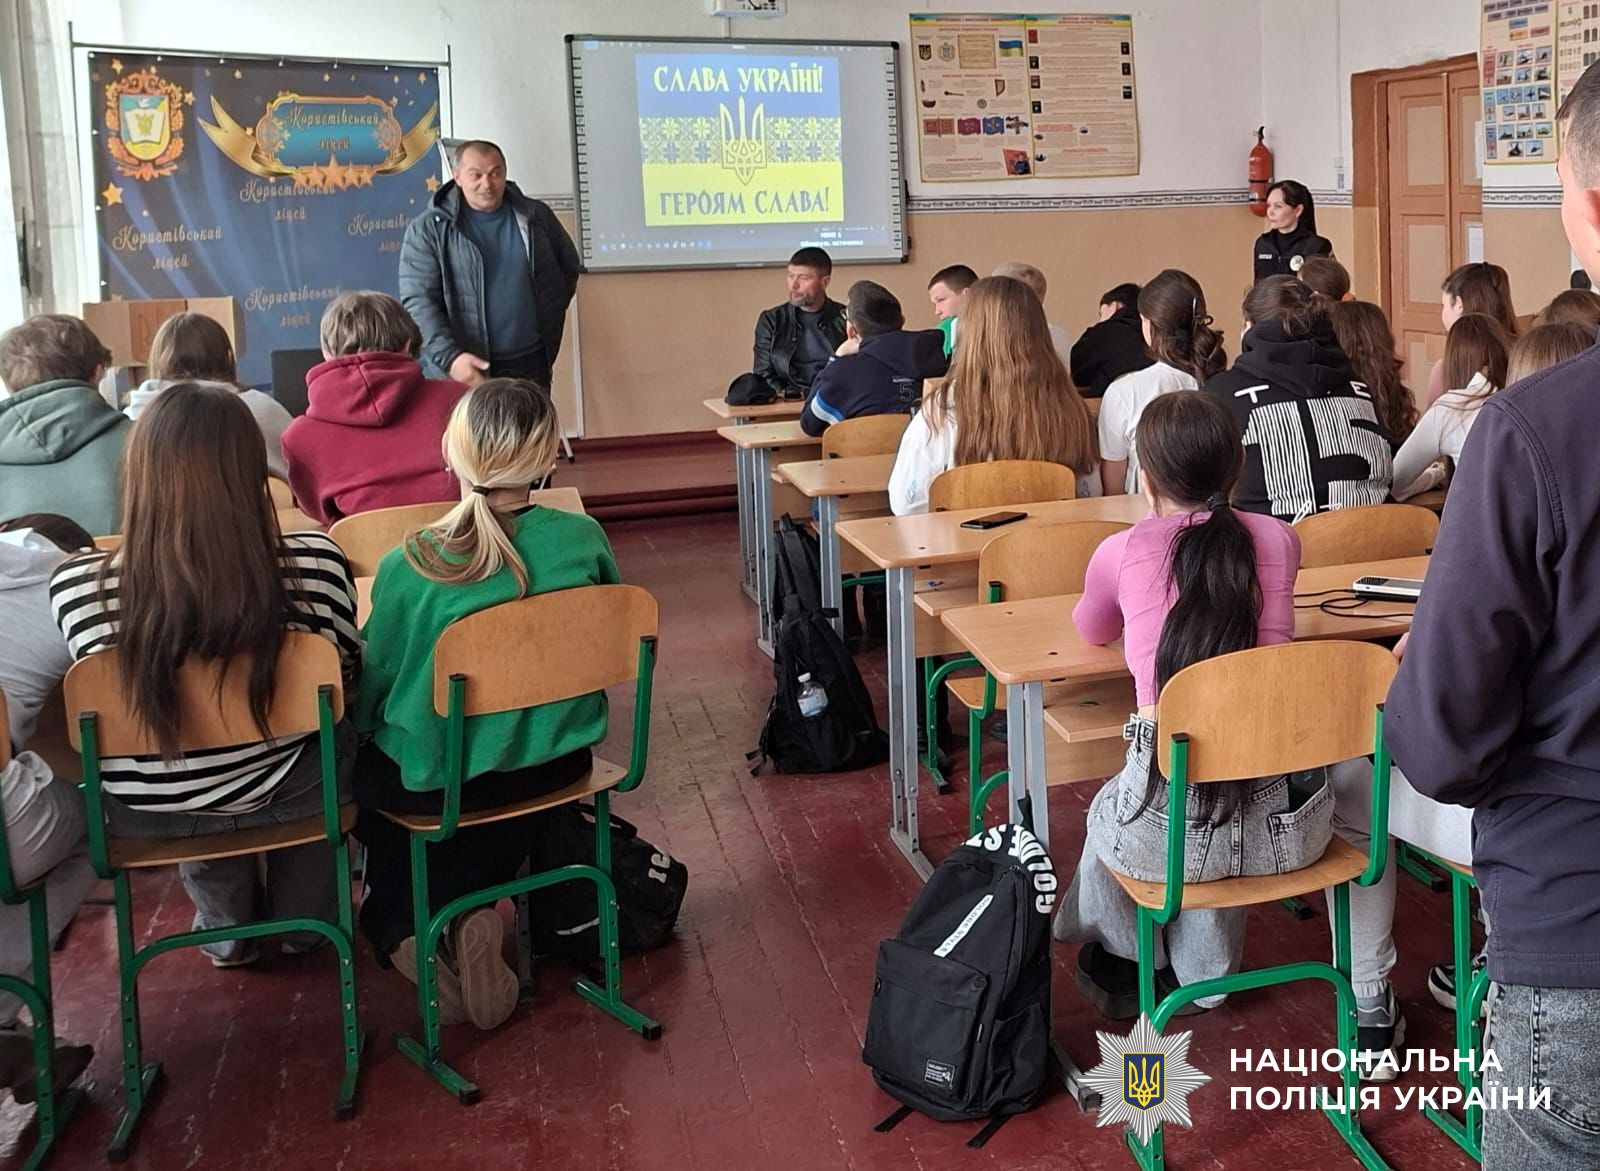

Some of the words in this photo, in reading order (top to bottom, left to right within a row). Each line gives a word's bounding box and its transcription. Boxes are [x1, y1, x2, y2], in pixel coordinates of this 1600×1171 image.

[654, 66, 730, 92] СЛАВА
[738, 62, 823, 93] УКРАЇНІ!
[285, 105, 379, 131] Користівський
[755, 187, 829, 214] СЛАВА!
[274, 206, 307, 224] ліцей
[112, 224, 223, 251] Користівський
[152, 253, 189, 271] ліцей
[1241, 396, 1393, 516] 15
